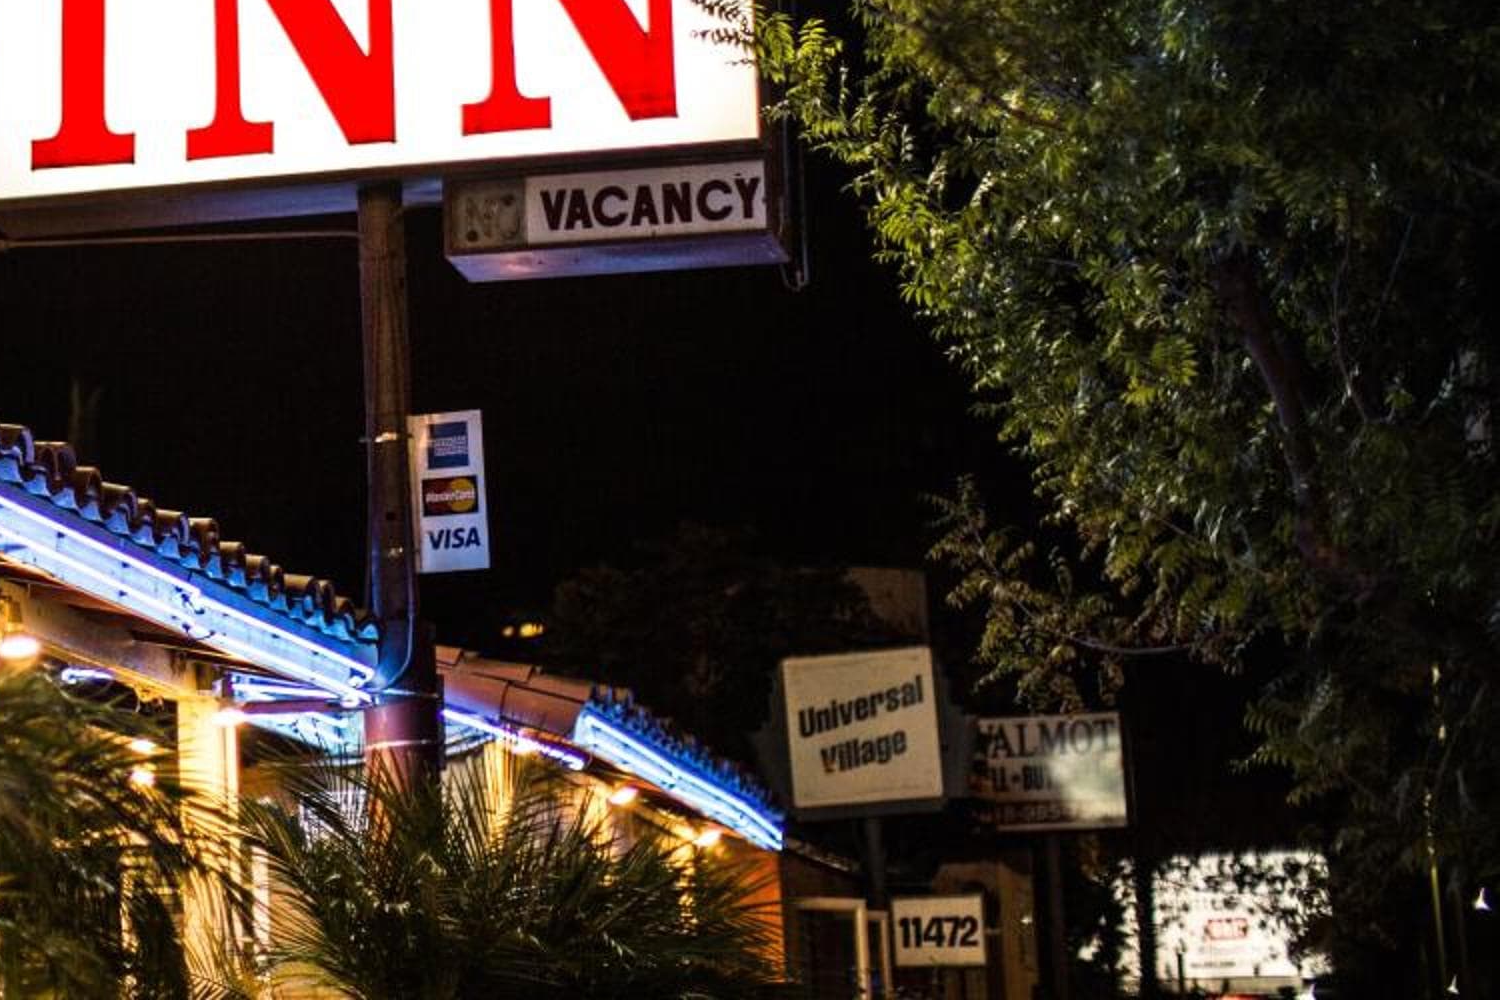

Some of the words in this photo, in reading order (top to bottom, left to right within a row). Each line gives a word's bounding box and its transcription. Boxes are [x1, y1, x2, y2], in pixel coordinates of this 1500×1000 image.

[540, 177, 760, 231] VACANCY
[429, 527, 481, 550] VISA
[799, 674, 923, 738] Universal
[820, 730, 907, 773] Village
[899, 915, 978, 949] 11472
